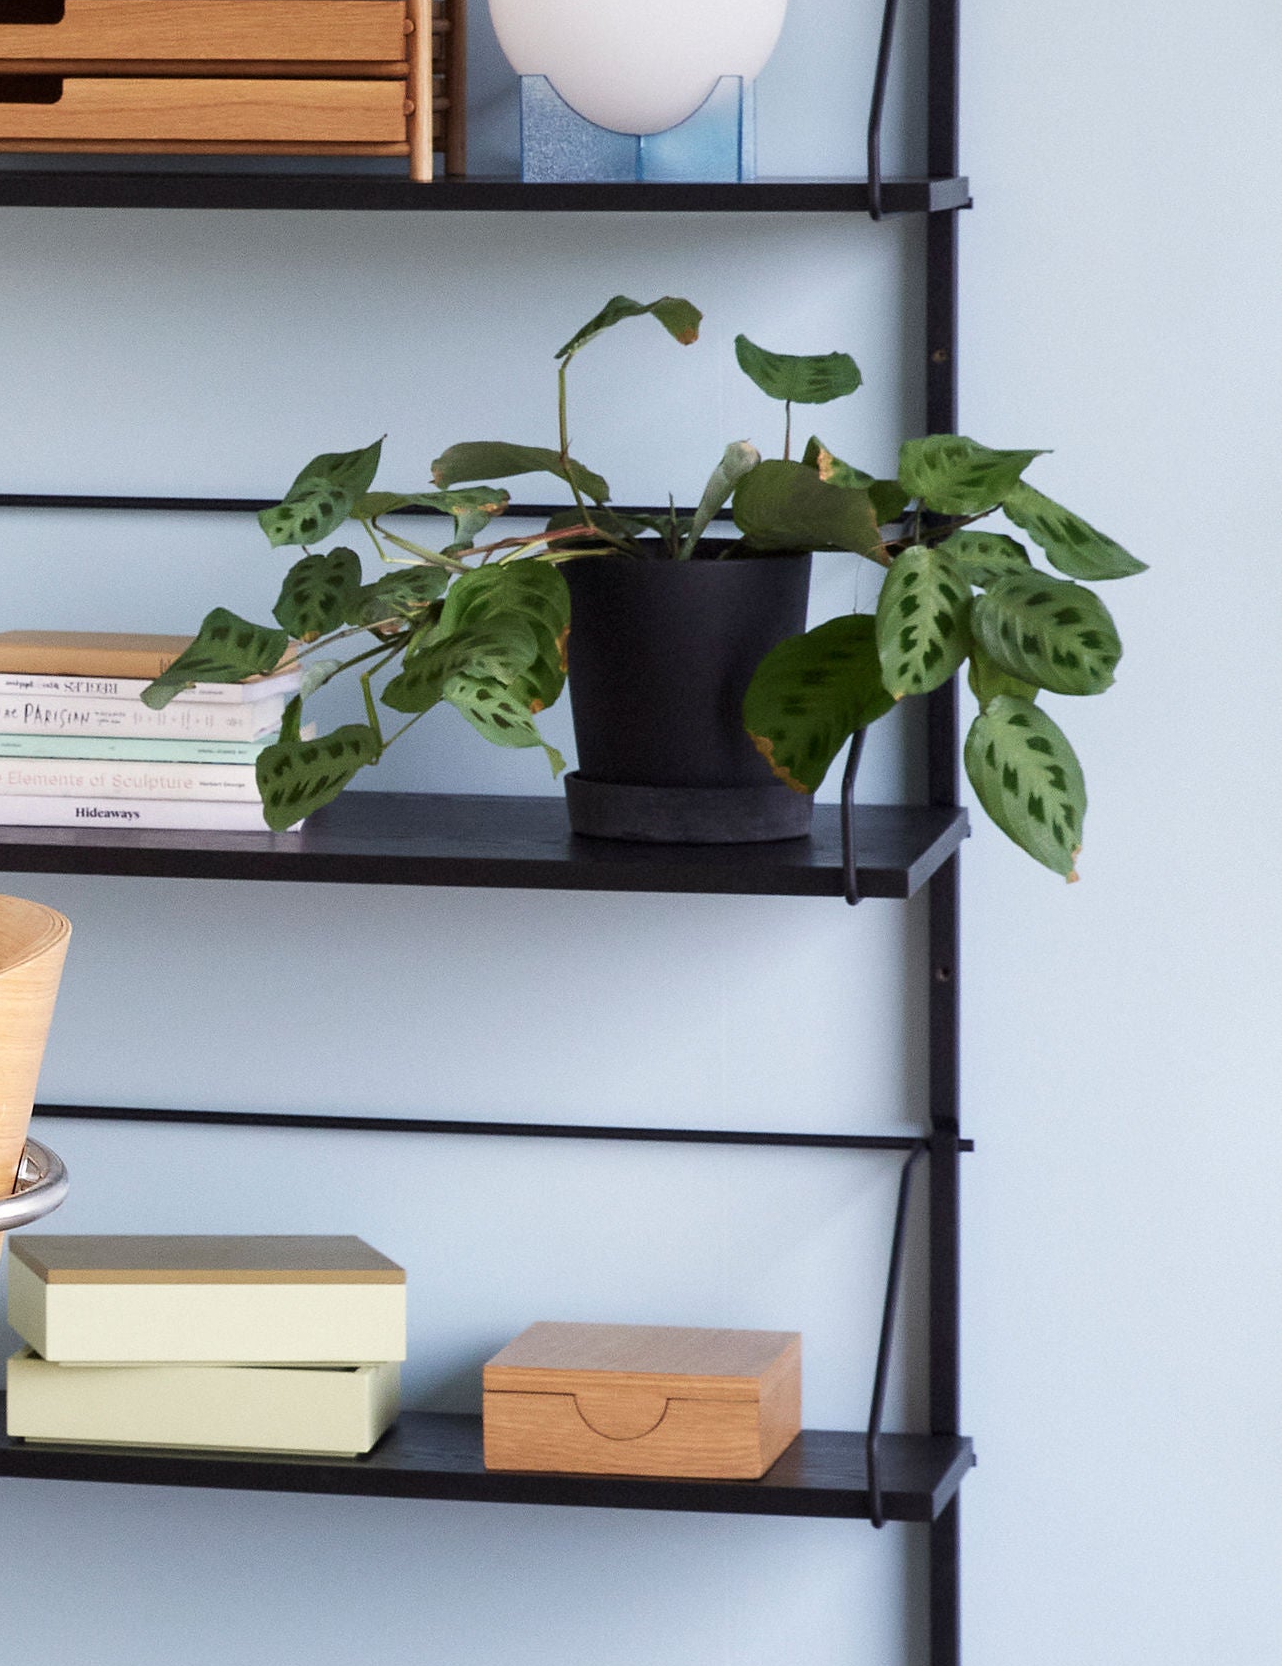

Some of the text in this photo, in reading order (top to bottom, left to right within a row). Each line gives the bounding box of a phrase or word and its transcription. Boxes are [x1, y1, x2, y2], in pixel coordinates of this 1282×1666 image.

[7, 770, 84, 787] Elements
[90, 773, 105, 787] of
[112, 774, 193, 791] Sculpture
[75, 807, 140, 821] Hideaways
